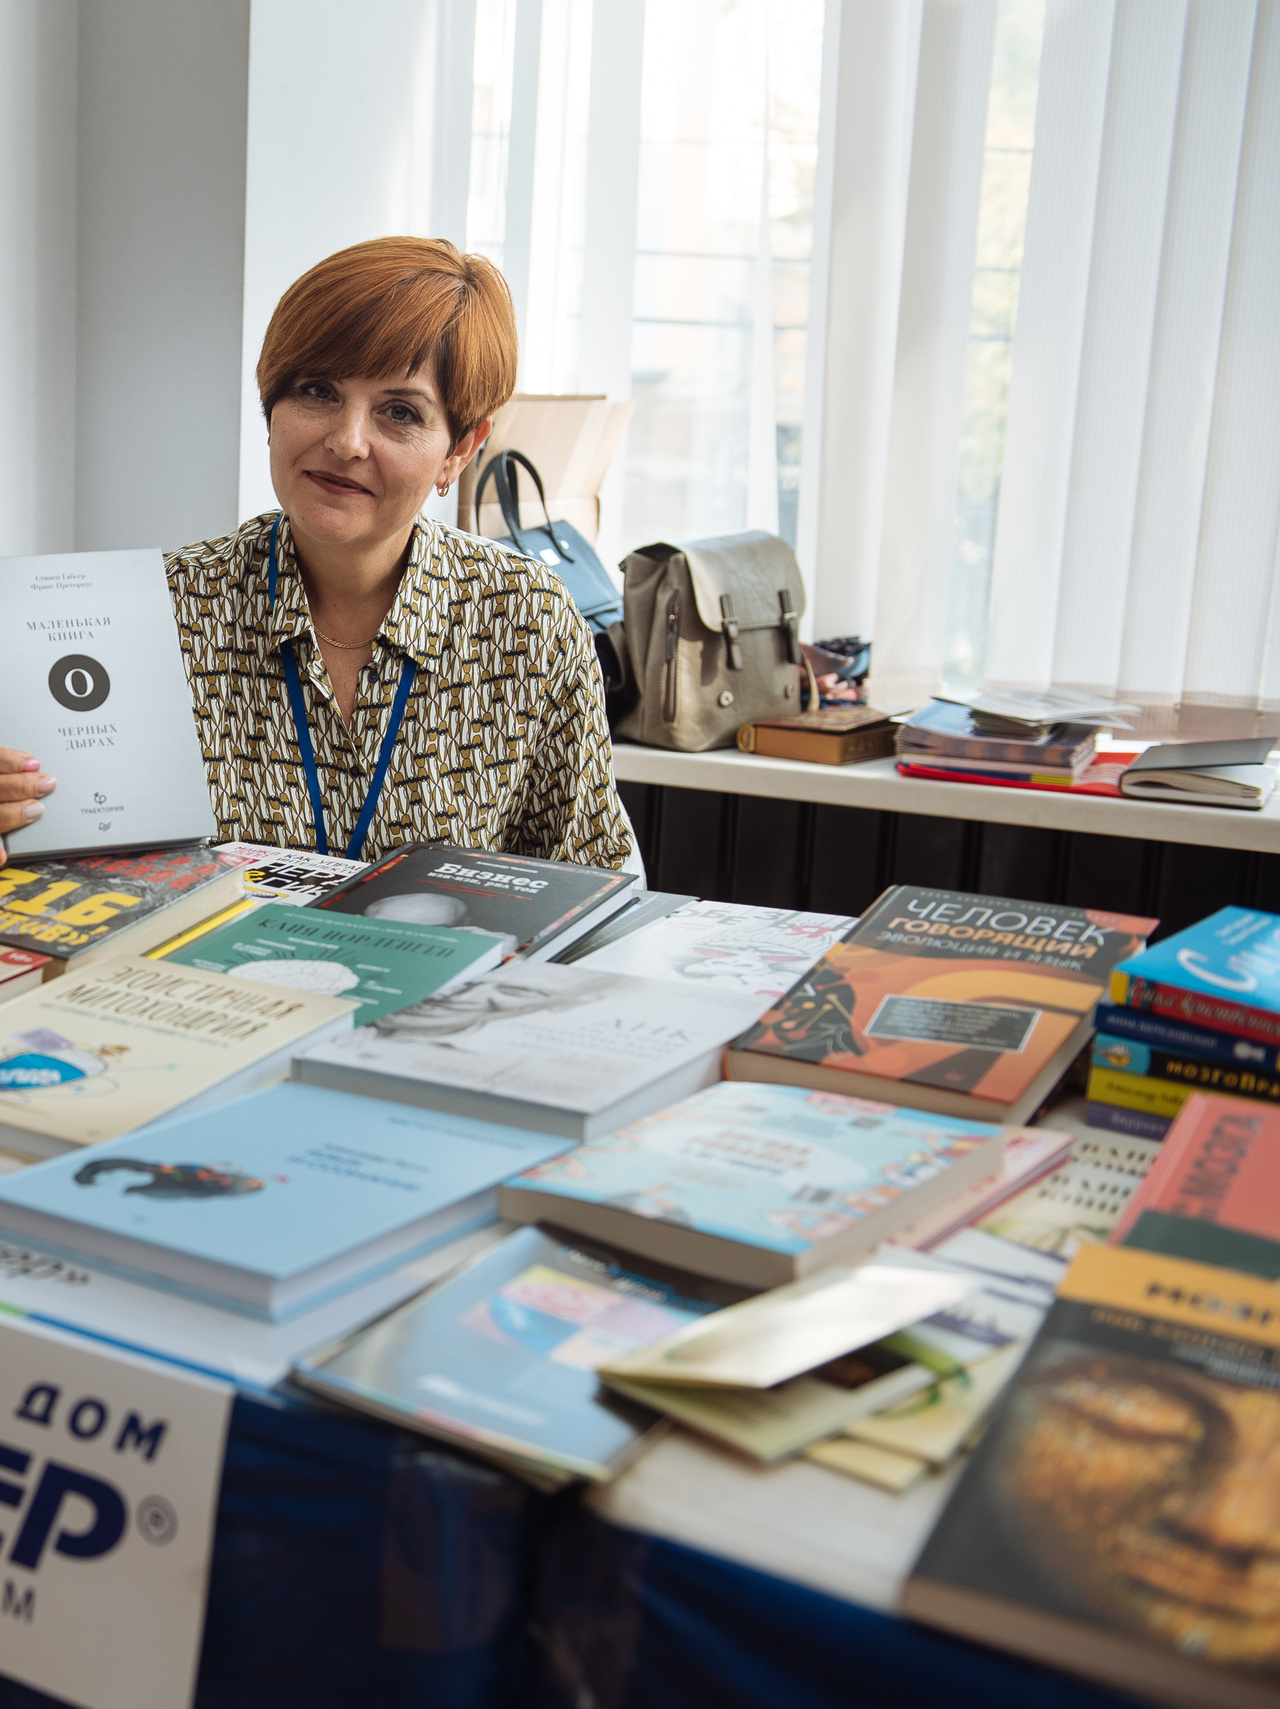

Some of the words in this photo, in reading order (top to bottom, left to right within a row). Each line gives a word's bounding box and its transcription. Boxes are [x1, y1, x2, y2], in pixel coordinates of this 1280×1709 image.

[26, 616, 111, 631] МАЛЕНЬКАЯ
[48, 631, 95, 641] КНИГА
[64, 668, 95, 698] О
[57, 723, 118, 738] ЧЕРНЫХ
[65, 737, 116, 751] ДЫРАХ
[80, 805, 125, 815] ТРАЕКТОРИЯ
[434, 862, 549, 889] Бизнес
[888, 916, 1099, 960] ГОВОРЯЩИЙ
[907, 898, 1115, 947] ЧЕЛОВЕК
[876, 930, 999, 958] ЭВОЛЮЦИЯ
[1001, 948, 1022, 961] И
[1025, 953, 1087, 972] ЯЗЫК
[94, 964, 305, 1022] ЭГОИСТИЧНАЯ
[55, 982, 272, 1041] МИТОХОНДРИЯ
[1165, 1060, 1280, 1098] МОЗГОПРА
[14, 1380, 172, 1466] ДОМ
